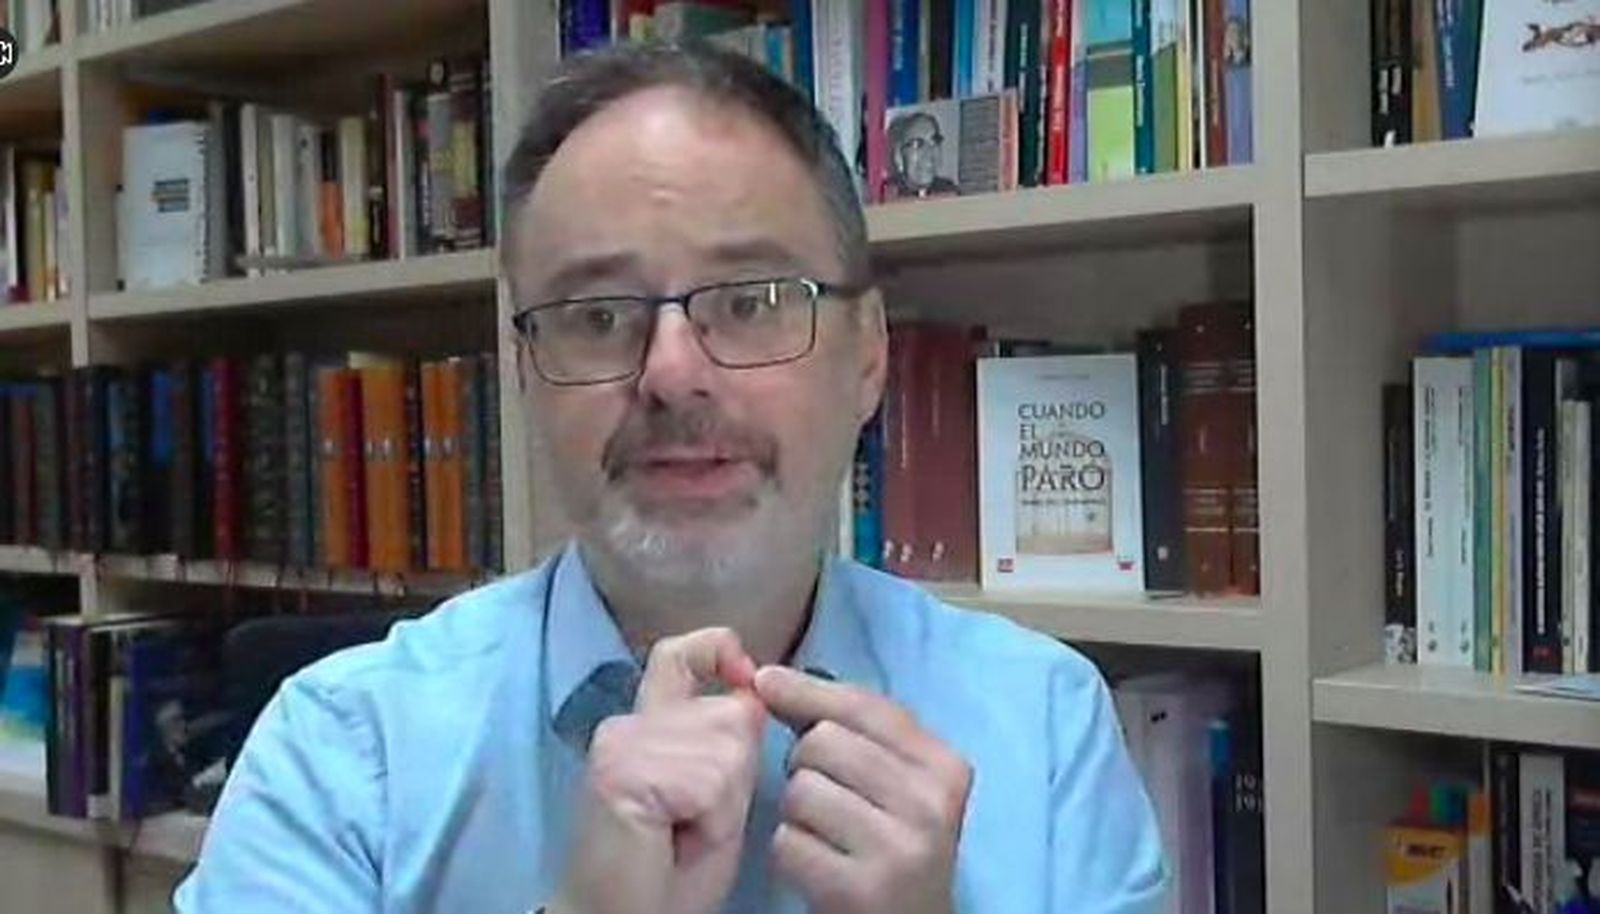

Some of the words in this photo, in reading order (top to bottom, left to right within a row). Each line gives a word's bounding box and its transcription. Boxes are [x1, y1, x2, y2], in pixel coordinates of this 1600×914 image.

[1018, 401, 1105, 420] CUANDO
[1020, 423, 1036, 440] EL
[1019, 439, 1105, 459] MUNDO
